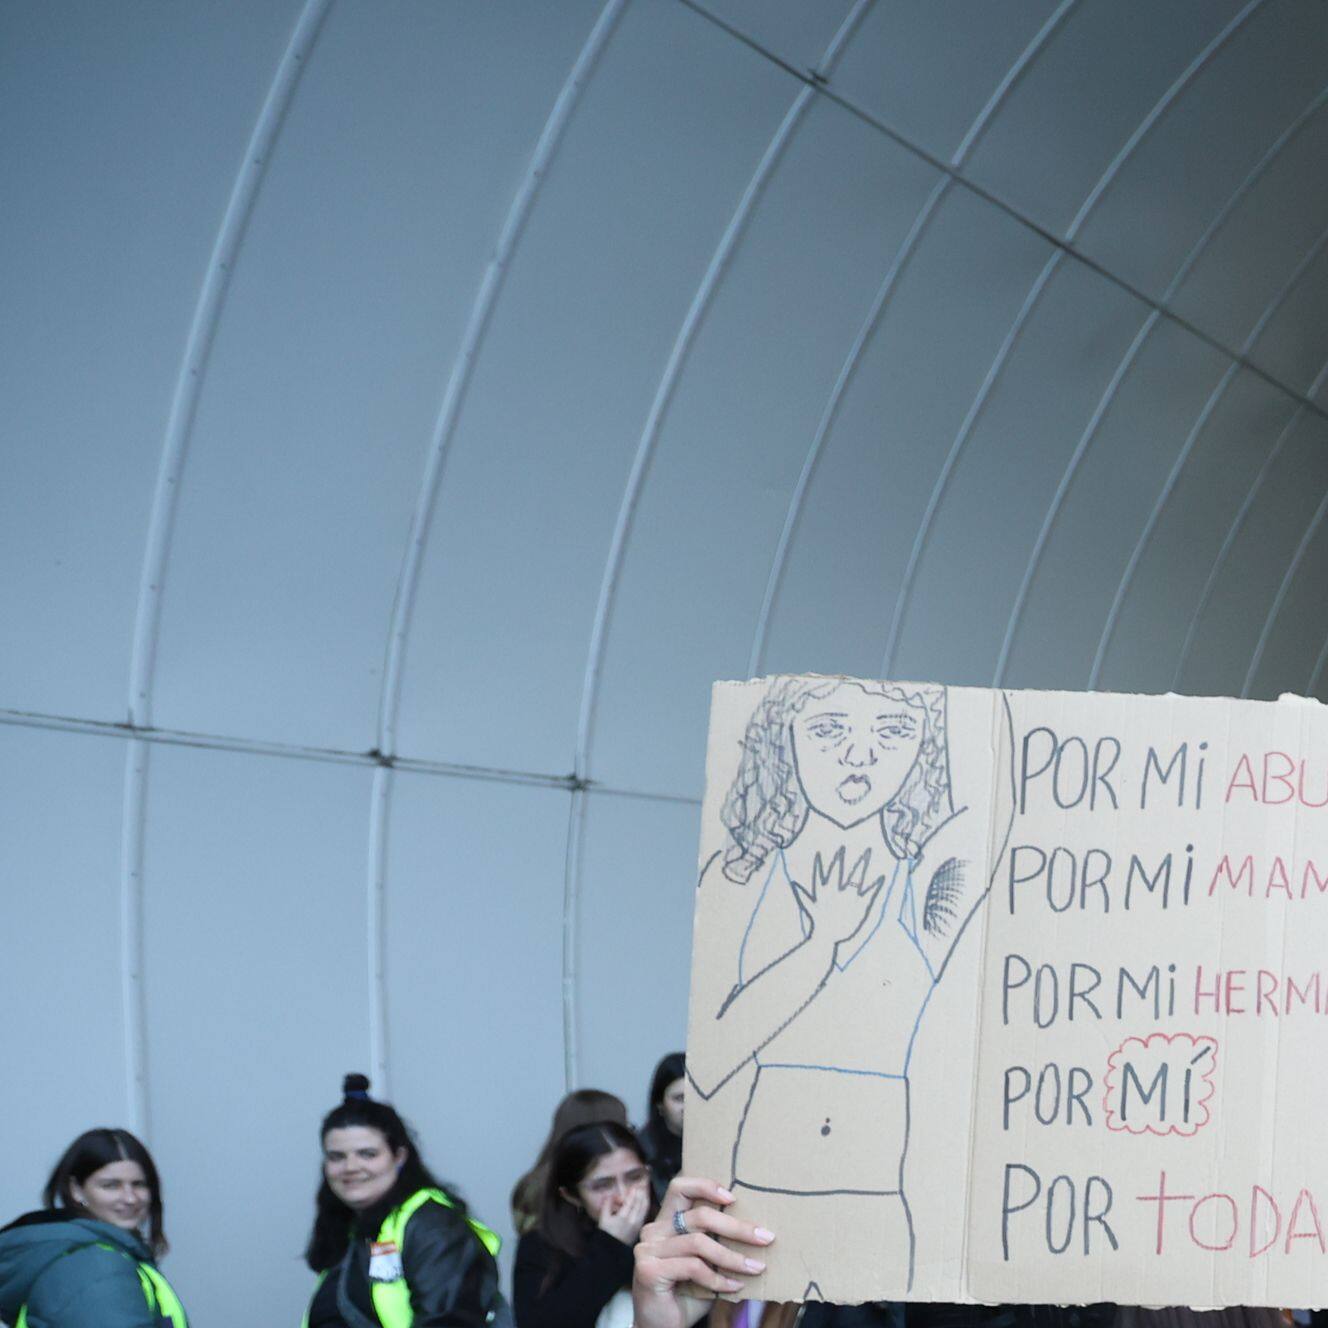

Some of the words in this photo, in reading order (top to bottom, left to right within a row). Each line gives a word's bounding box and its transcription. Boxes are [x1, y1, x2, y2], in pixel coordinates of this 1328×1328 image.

[1020, 727, 1121, 815] POR
[1009, 845, 1112, 915] POR
[1003, 954, 1102, 1029] POR
[1003, 1062, 1093, 1130] POR
[1121, 1046, 1211, 1123] MÍ
[1002, 1163, 1119, 1262] POR
